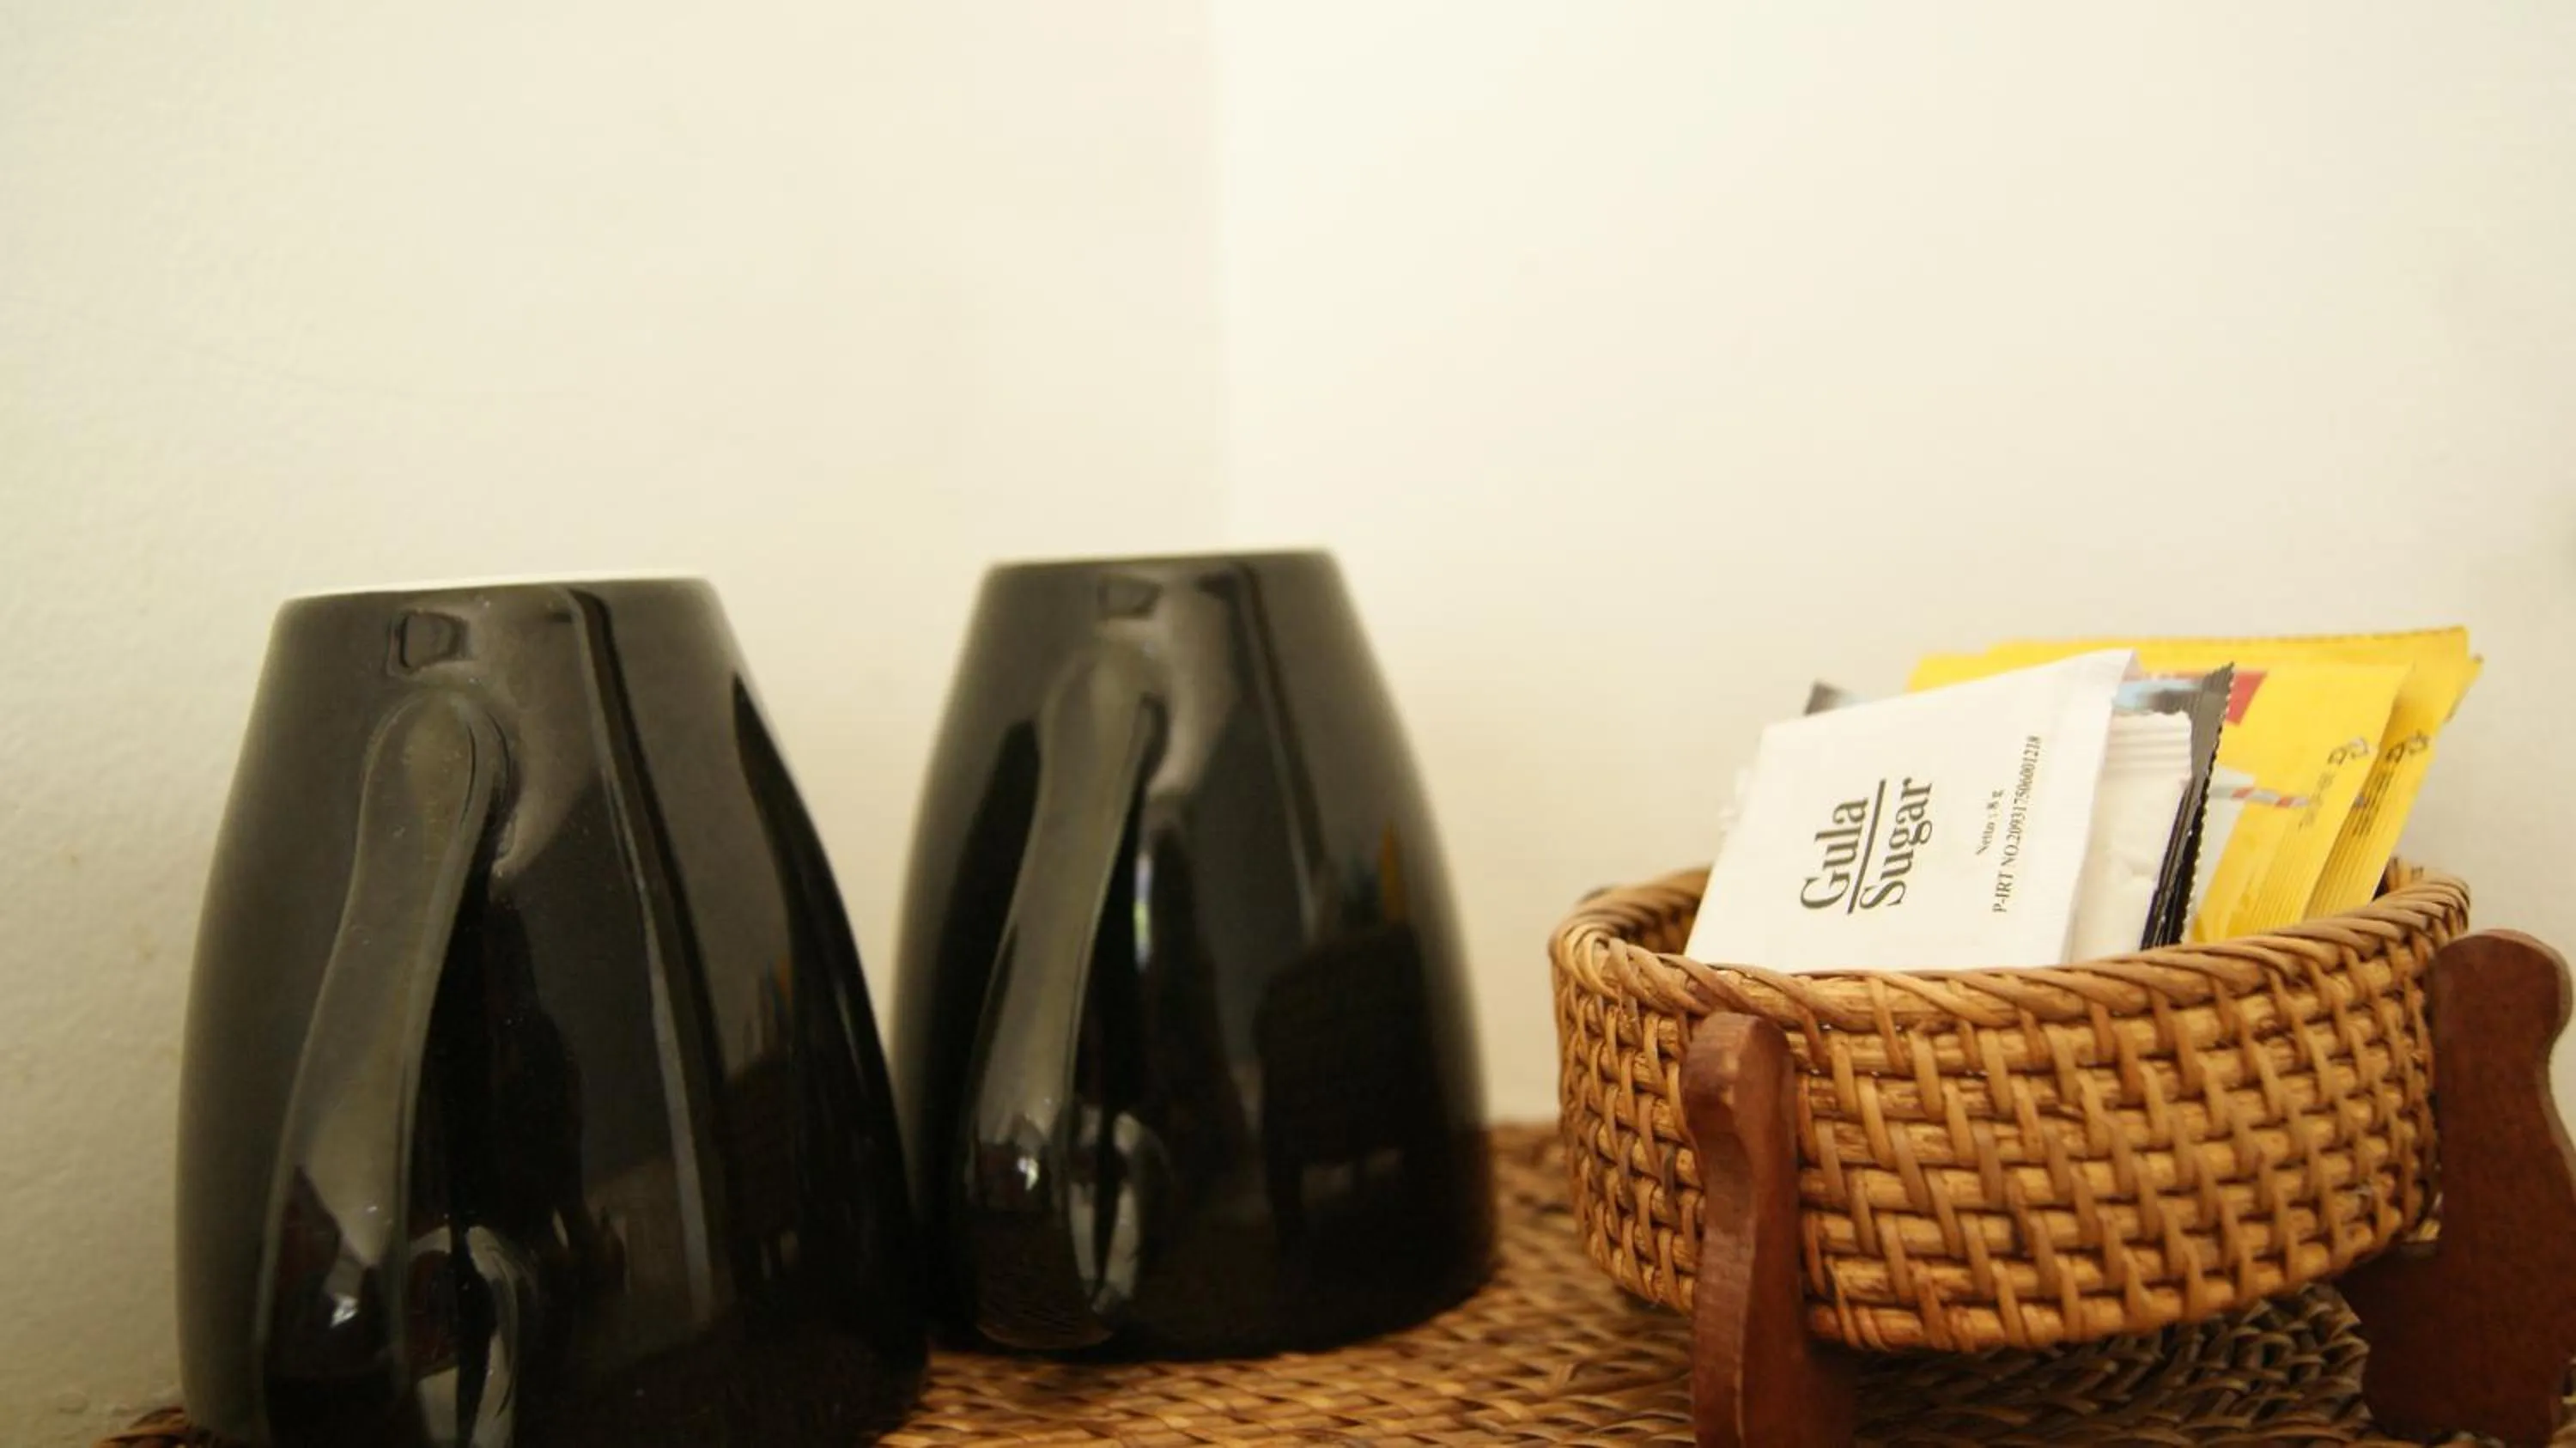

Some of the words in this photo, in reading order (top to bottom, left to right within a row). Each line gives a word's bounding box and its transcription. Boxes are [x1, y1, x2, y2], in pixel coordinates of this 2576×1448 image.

[1801, 797, 1868, 909] Gula
[1860, 776, 1932, 910] Sugar
[1975, 821, 1996, 855] Netto
[1992, 870, 2014, 913] P-IRT
